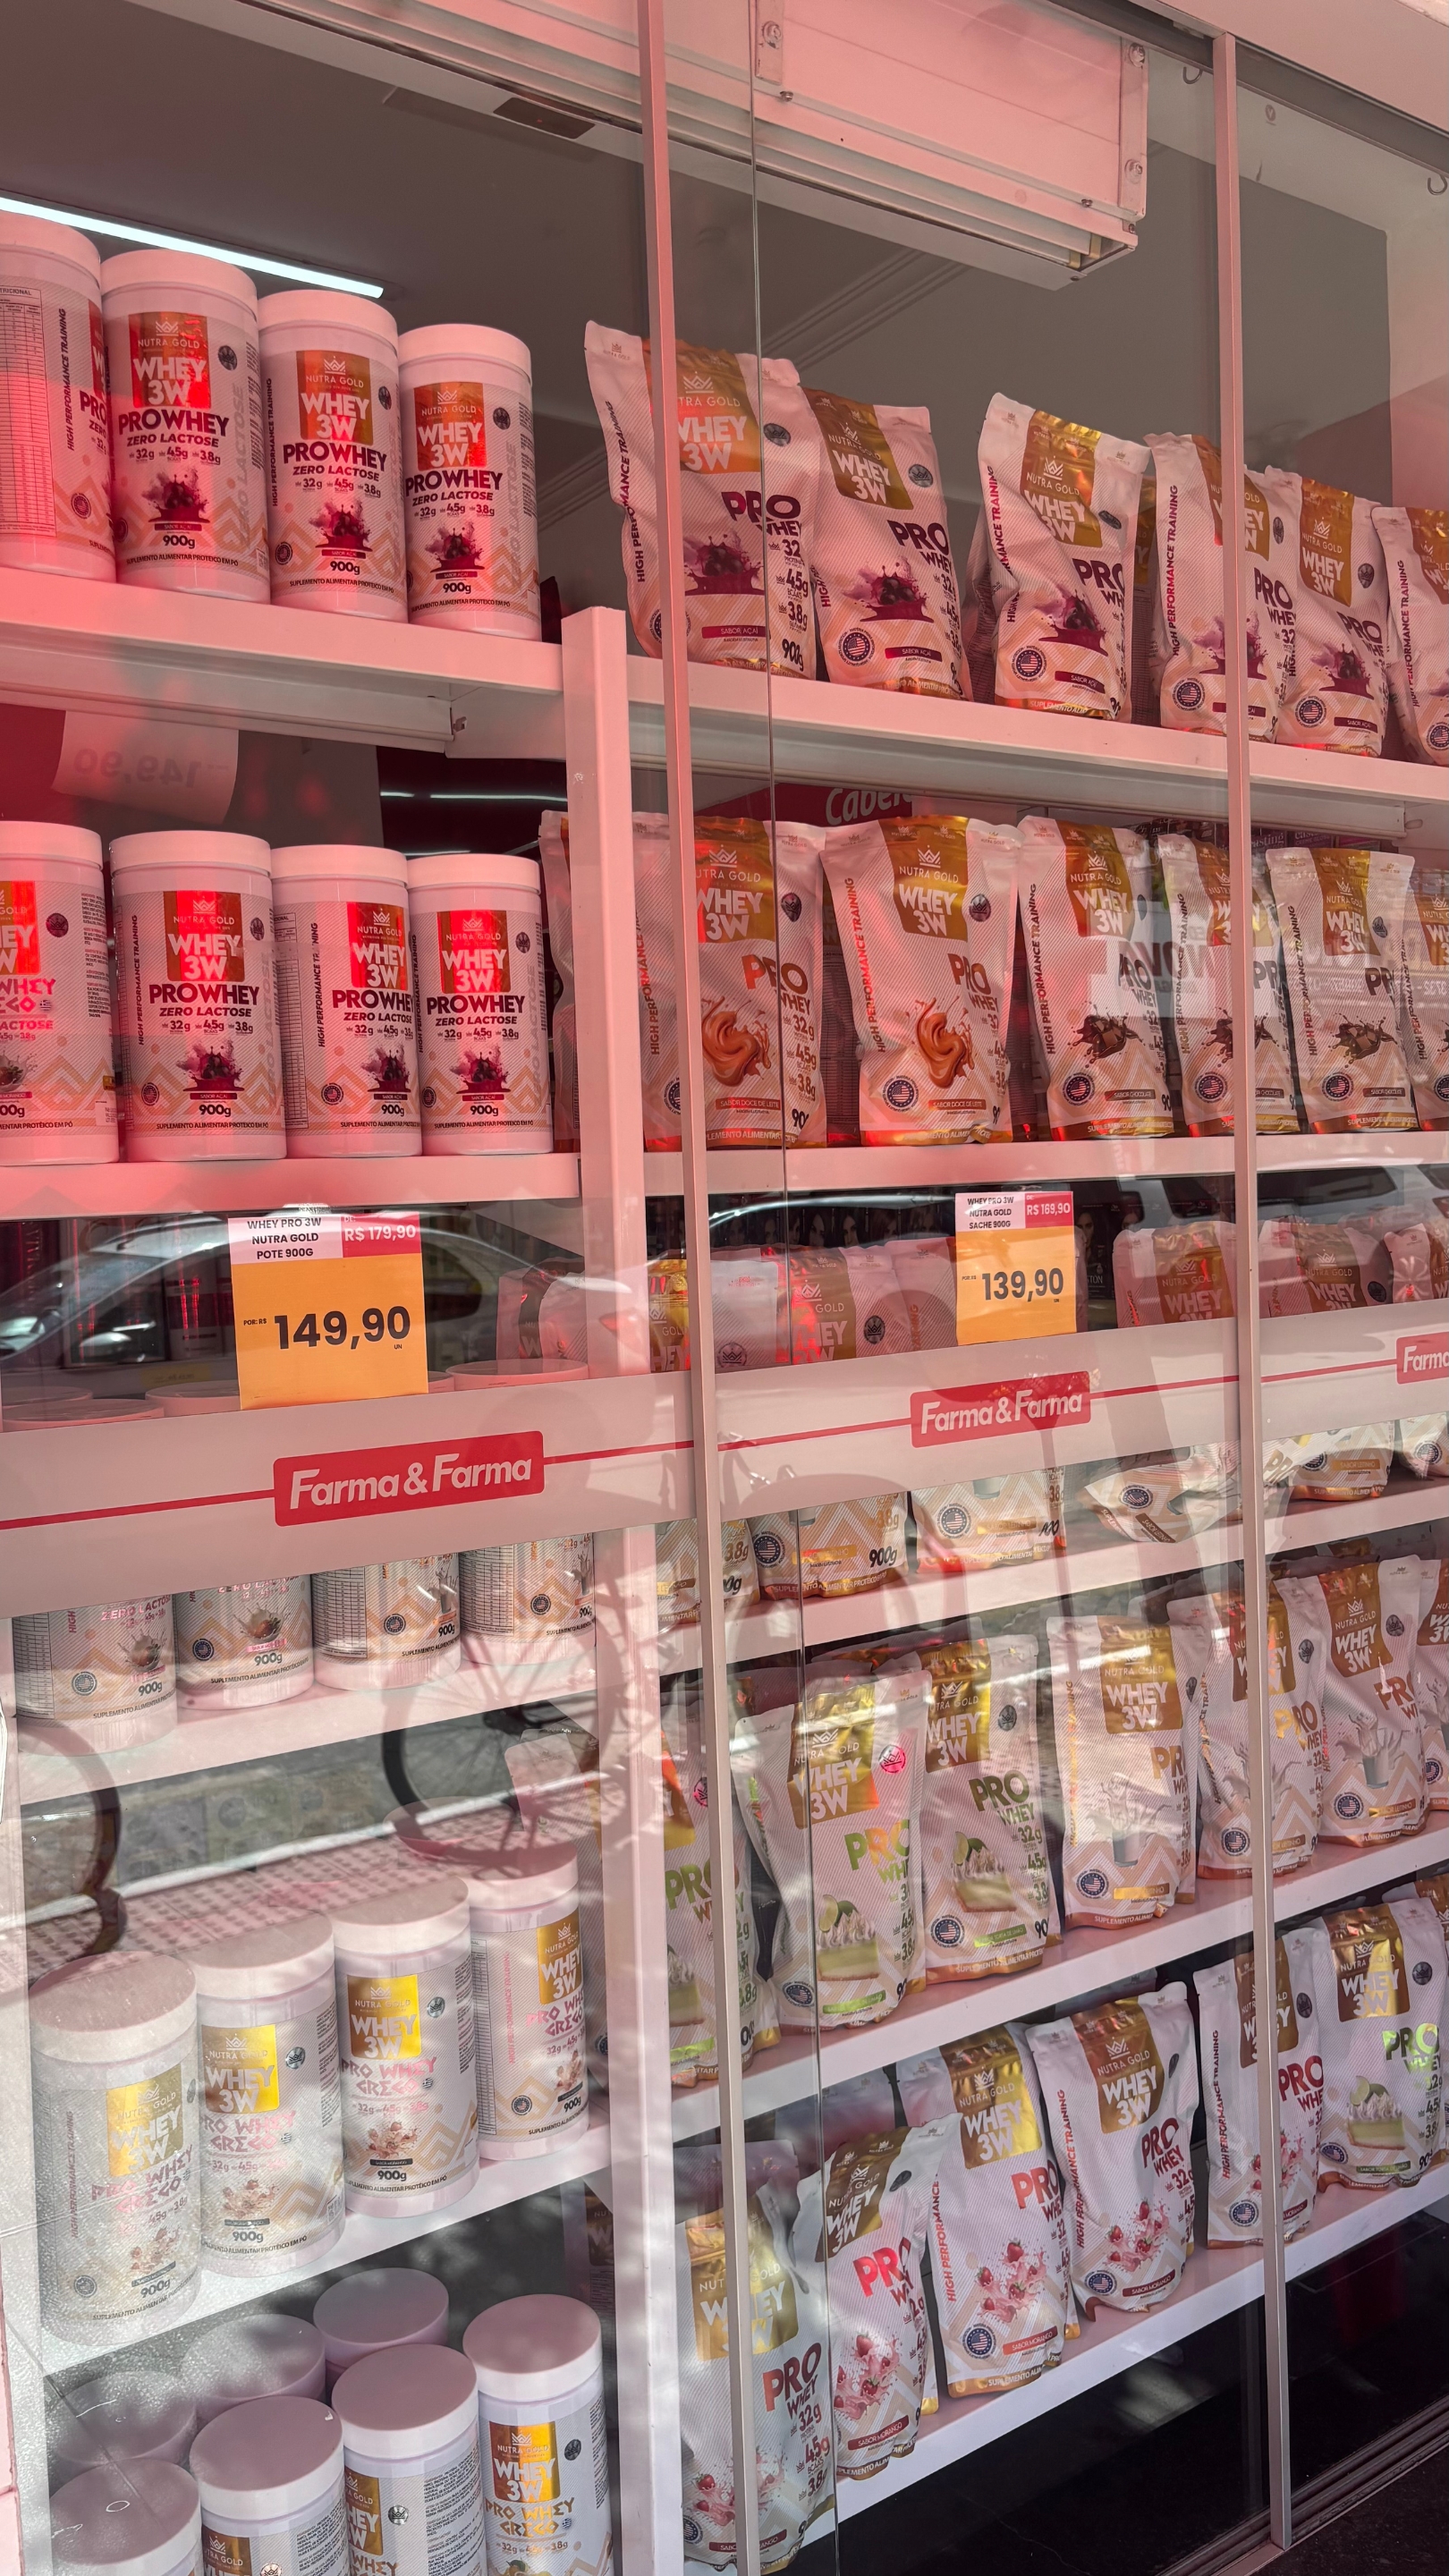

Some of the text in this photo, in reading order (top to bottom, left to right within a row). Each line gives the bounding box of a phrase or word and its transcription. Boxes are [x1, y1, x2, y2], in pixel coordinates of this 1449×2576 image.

[138, 339, 200, 350] NUTRA GOLD
[58, 308, 75, 451] HIGH PERFORMANCE TRAINING
[132, 358, 207, 382] WHEY
[306, 376, 364, 388] NUTRA GOLD
[148, 381, 190, 404] 3W
[301, 393, 369, 419] WHEY
[118, 409, 229, 436] PROWHEY
[317, 414, 356, 440] 3W
[418, 421, 483, 446] WHEY
[127, 433, 219, 447] ZERO LACTOSE
[136, 449, 154, 461] 32g
[284, 442, 386, 471] PROWHEY
[430, 444, 469, 468] 3W
[684, 443, 733, 471] 3W
[292, 465, 379, 481] ZERO LACTOSE
[834, 450, 890, 486] WHEY
[405, 470, 503, 496] PROWHEY
[853, 476, 887, 504] 3W
[721, 491, 801, 522] PRO
[1023, 490, 1086, 524] WHEY
[163, 536, 195, 548] 900g
[887, 520, 949, 552] PRO
[330, 561, 360, 574] 900g
[1301, 546, 1344, 581] WHEY
[443, 582, 471, 593] 900g
[1254, 567, 1293, 610] PRO
[899, 866, 959, 884] NUTRA GOLD
[1071, 871, 1122, 886] NUTRA GOLD
[899, 884, 958, 911] WHEY
[1073, 890, 1128, 916] WHEY
[174, 916, 235, 926] NUTRA GOLD
[705, 914, 749, 940] 3W
[913, 910, 947, 936] 3W
[1096, 914, 1123, 936] 3W
[1326, 911, 1366, 935] WHEY
[167, 933, 242, 957] WHEY
[352, 943, 404, 967] WHEY
[184, 956, 227, 980] 3W
[442, 949, 506, 970] WHEY
[1028, 884, 1055, 1055] HIGH PERFORMANCE TRAINING
[741, 953, 808, 996] PRO
[948, 953, 992, 996] PRO
[149, 984, 259, 1005] PROWHEY
[333, 989, 414, 1013] PROWHEY
[427, 995, 525, 1015] PROWHEY
[159, 1007, 251, 1017] ZERO LACTOSE
[436, 1016, 517, 1026] ZERO LACTOSE
[199, 1105, 231, 1117] 900g
[470, 1105, 498, 1116] 900g
[1027, 1205, 1038, 1216] R$
[248, 1217, 322, 1230] WHEY PRO 3W
[344, 1224, 416, 1242] R$ 179,90
[970, 1221, 992, 1229] SACHE
[252, 1233, 319, 1245] NUTRA GOLD
[257, 1248, 314, 1259] POTE 900G
[982, 1268, 1063, 1302] 139,90
[1162, 1274, 1217, 1287] NUTRA GOLD
[1313, 1284, 1356, 1302] WHEY
[1165, 1289, 1223, 1315] WHEY
[274, 1306, 411, 1350] 149,90
[921, 1389, 1082, 1435] Farma&Farma
[290, 1453, 532, 1510] Farma&Farma
[869, 1546, 897, 1569] 900g
[1335, 1624, 1377, 1656] WHEY
[254, 1651, 284, 1666] 900g
[953, 1695, 979, 1708] GOLD
[1106, 1682, 1169, 1707] WHEY
[926, 1712, 981, 1743] WHEY
[1122, 1704, 1158, 1731] 3W
[937, 1736, 968, 1767] 3W
[968, 1770, 1030, 1813] PRO
[996, 1802, 1036, 1827] WHEY
[1342, 1969, 1400, 1996] WHEY
[1353, 1992, 1389, 2016] 3W
[352, 2013, 416, 2038] WHEY
[363, 2036, 404, 2058] 3W
[1097, 2049, 1150, 2077] NUTRA GOLD
[204, 2065, 275, 2090] WHEY
[1102, 2065, 1157, 2104] WHEY
[218, 2088, 259, 2114] 3W
[564, 2096, 582, 2114] 900g
[959, 2081, 1015, 2110] NUTRA GOLD
[963, 2099, 1023, 2142] WHEY
[1116, 2094, 1152, 2128] 3W
[979, 2131, 1014, 2161] 3W
[1141, 2117, 1180, 2168] PRO
[377, 2169, 407, 2182] 900g
[233, 2230, 264, 2243] 900g
[762, 2342, 822, 2413] PRO
[494, 2458, 555, 2484] WHEY
[505, 2479, 543, 2503] 3W
